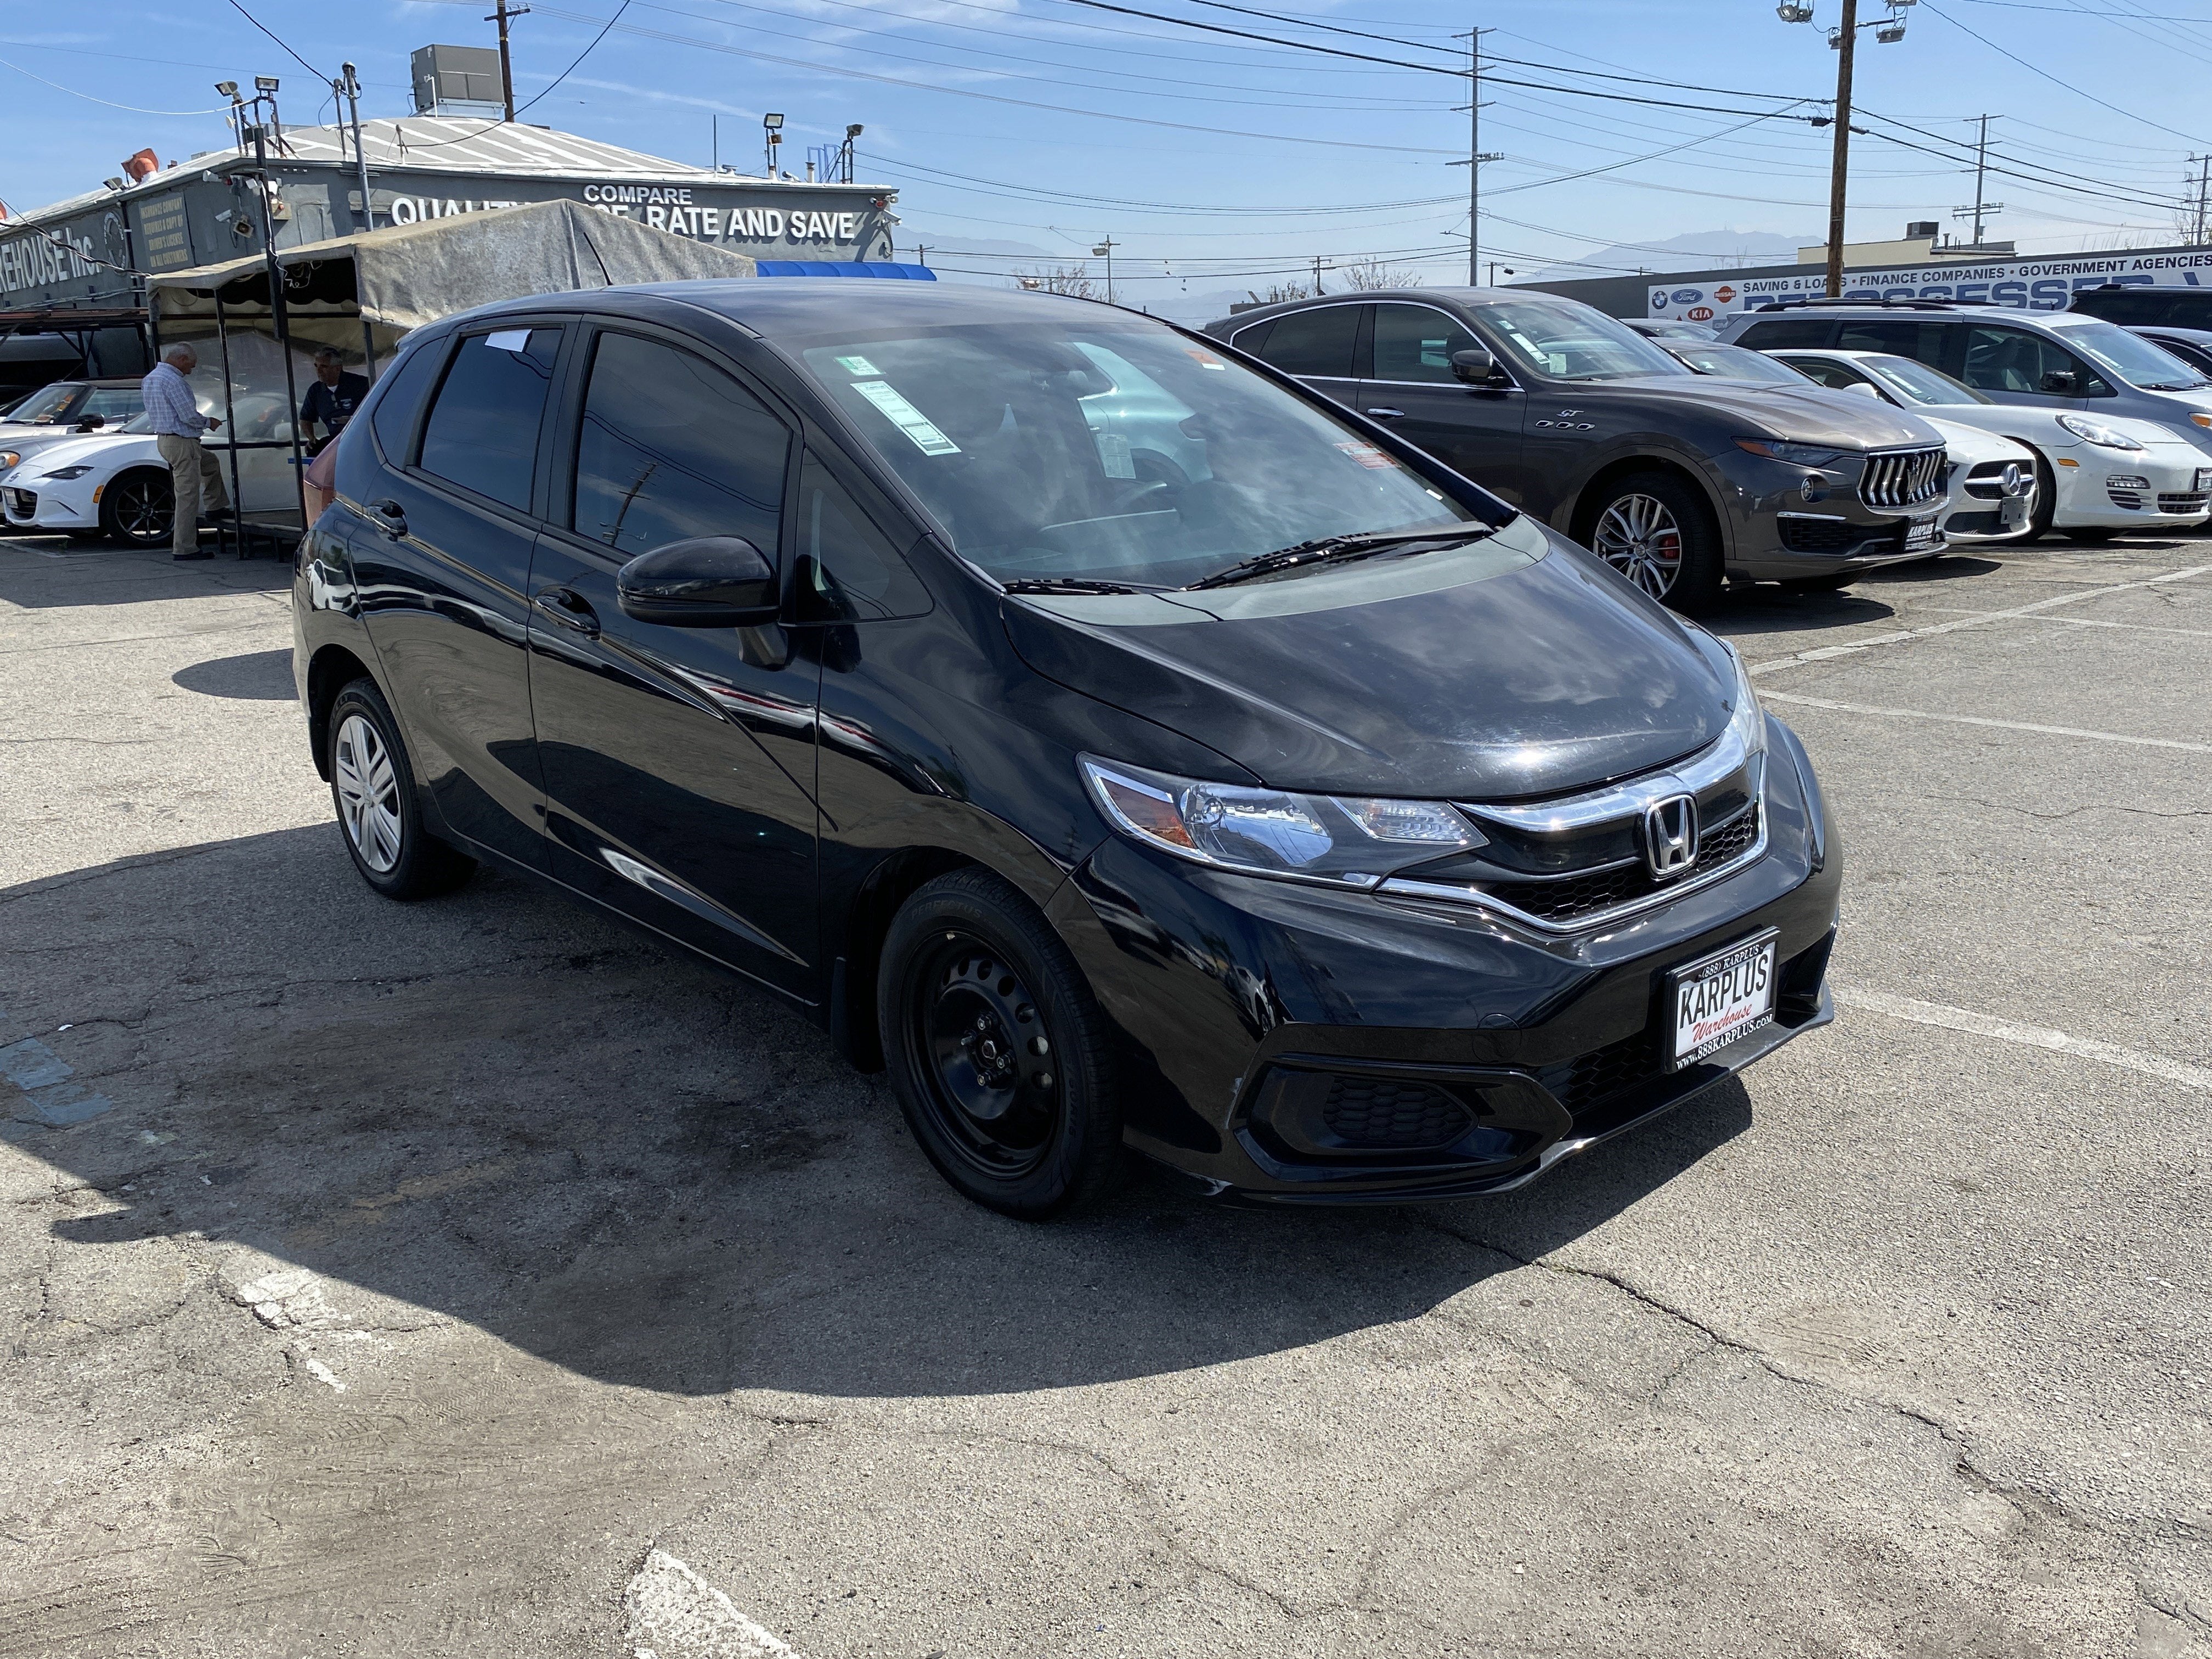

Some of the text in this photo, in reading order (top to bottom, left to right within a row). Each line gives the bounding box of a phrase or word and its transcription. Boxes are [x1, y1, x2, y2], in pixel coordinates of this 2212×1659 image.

[583, 184, 692, 206] COMPARE
[646, 206, 720, 235] RATE
[728, 208, 785, 237] AND
[790, 211, 855, 239] SAVE
[1742, 255, 2212, 292] SAVING & LOAS FINANCE COMPANIES GOVERNMENT AGENCIES
[1677, 292, 1696, 301] Ford
[1691, 309, 1711, 319] KIA
[1701, 944, 1760, 979] (888) KARPLUS
[1680, 953, 1769, 1030] KARPLUS
[1692, 1003, 1753, 1043] Warehouse
